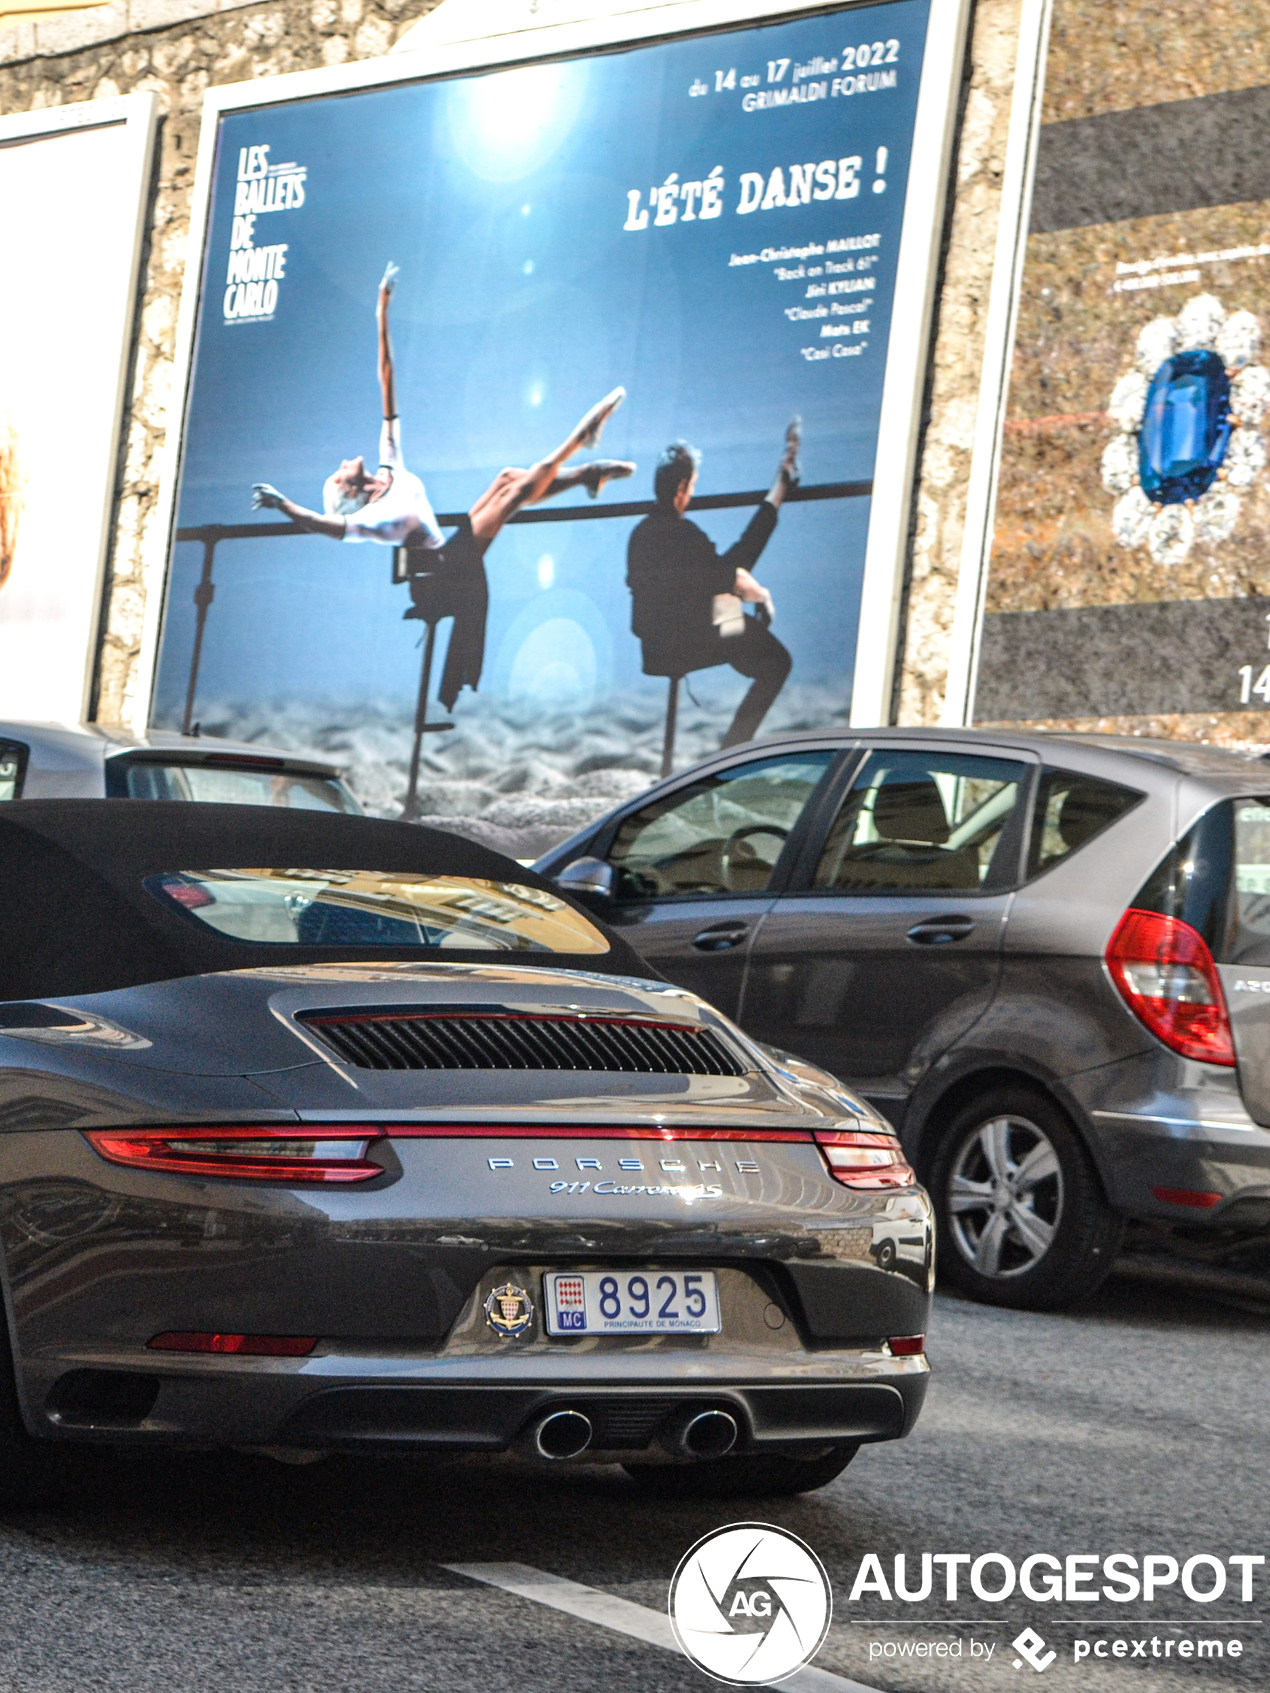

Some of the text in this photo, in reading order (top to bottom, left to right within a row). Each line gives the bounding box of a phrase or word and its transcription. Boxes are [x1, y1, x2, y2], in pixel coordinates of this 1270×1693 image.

[688, 38, 900, 97] du 14 au 17 juillet 2022
[741, 69, 898, 112] GRIMALDI FORUM
[237, 144, 270, 181] LES
[234, 173, 307, 216] BALLETS
[623, 145, 889, 231] L'ÉTÉ DANSE !
[230, 214, 257, 251] DE
[226, 243, 288, 285] MONTE
[223, 279, 279, 319] CARLO
[487, 1157, 760, 1173] PORSCHE
[550, 1180, 590, 1194] 911
[599, 1276, 706, 1319] 8925
[563, 1313, 582, 1326] MC
[669, 1320, 701, 1328] MONACO
